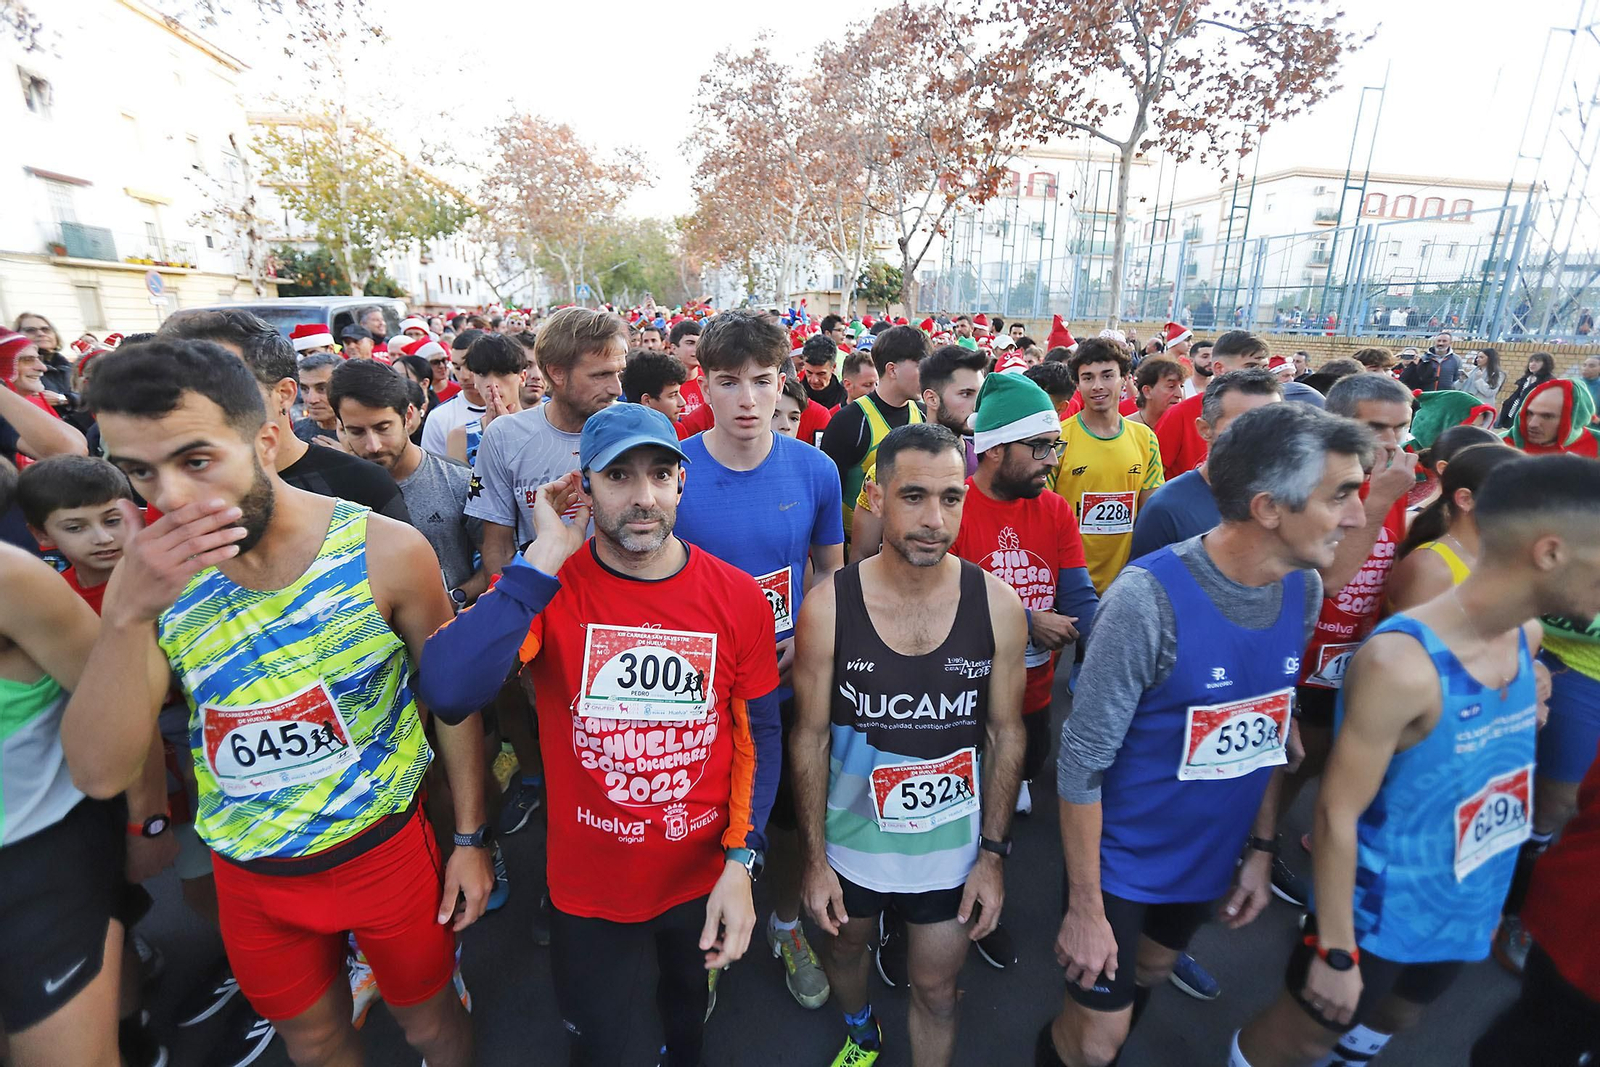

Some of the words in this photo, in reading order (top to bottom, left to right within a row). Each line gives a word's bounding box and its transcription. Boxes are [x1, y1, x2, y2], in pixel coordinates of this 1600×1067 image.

[1095, 504, 1123, 521] 228
[990, 550, 1029, 569] XIII
[617, 653, 682, 692] 300
[880, 722, 888, 730] de
[914, 723, 944, 731] cuestión
[1216, 717, 1267, 755] 533
[230, 722, 308, 768] 645
[575, 731, 603, 753] DE
[602, 724, 716, 761] HUELVA
[581, 751, 614, 773] 30
[614, 761, 636, 774] DE
[636, 747, 707, 773] DICIEMBRE
[605, 769, 692, 803] 2023
[901, 776, 953, 811] 532
[577, 806, 646, 836] Huelva
[690, 811, 719, 832] HUELVA
[618, 836, 645, 845] original
